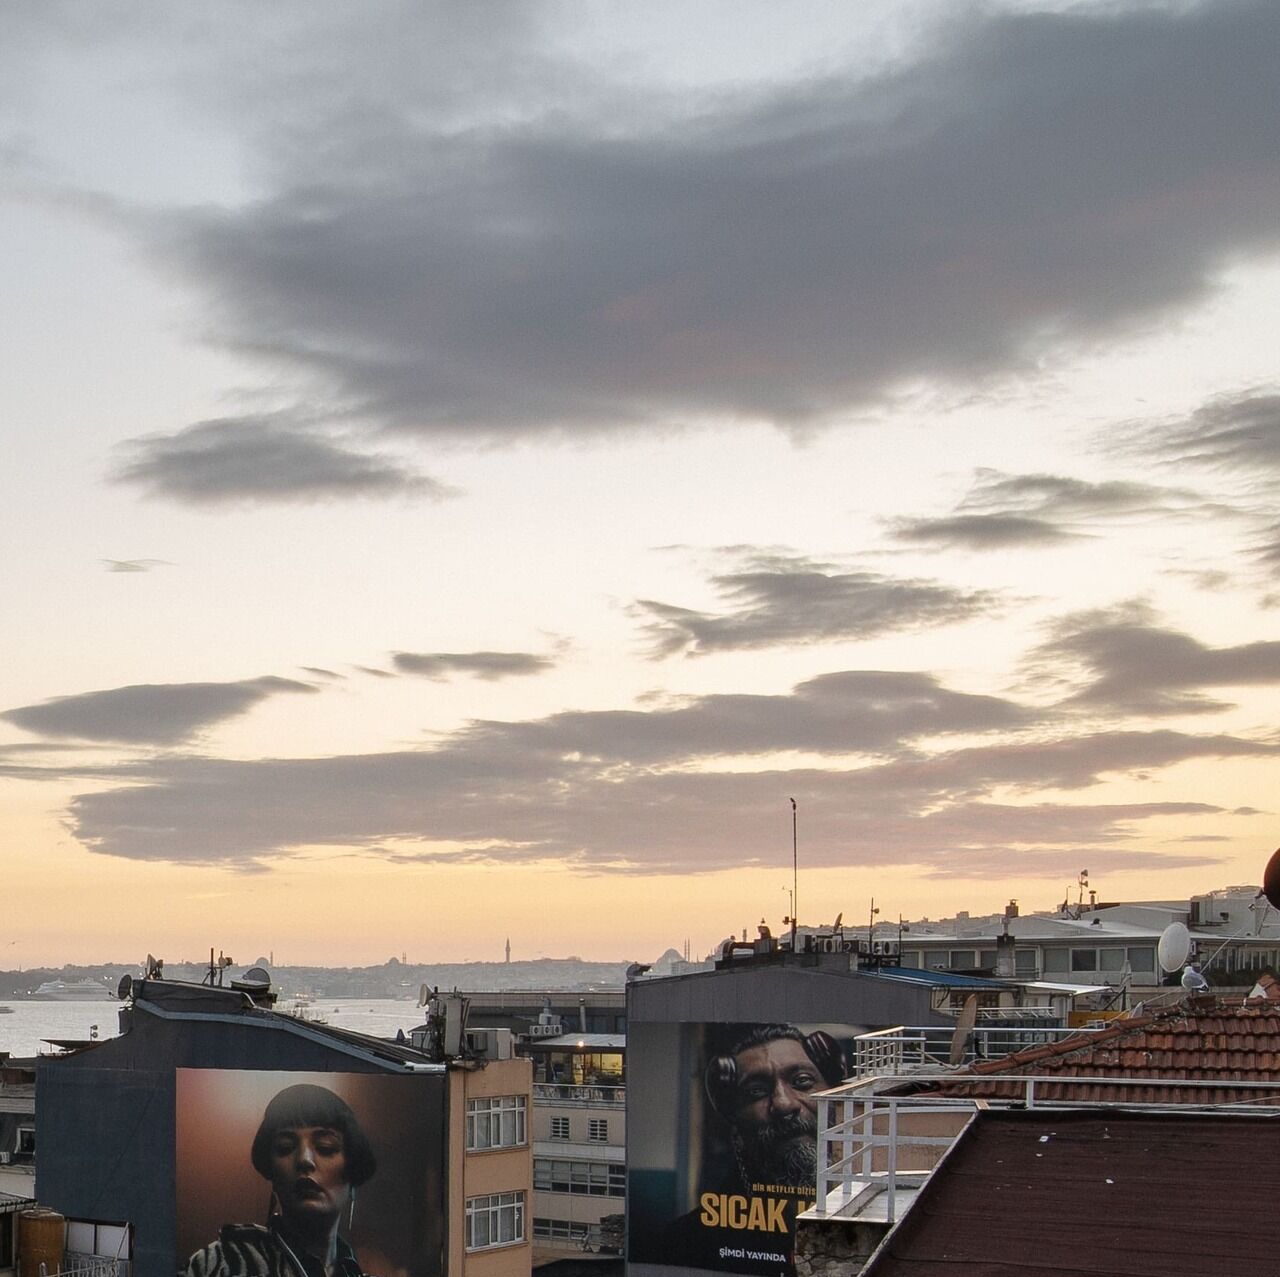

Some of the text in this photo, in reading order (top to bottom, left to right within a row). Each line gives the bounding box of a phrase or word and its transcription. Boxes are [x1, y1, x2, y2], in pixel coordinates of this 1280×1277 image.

[766, 1184, 795, 1194] NETFLIX
[700, 1191, 789, 1233] SICAK
[719, 1246, 787, 1263] ŞİMDİ YAYINDA
